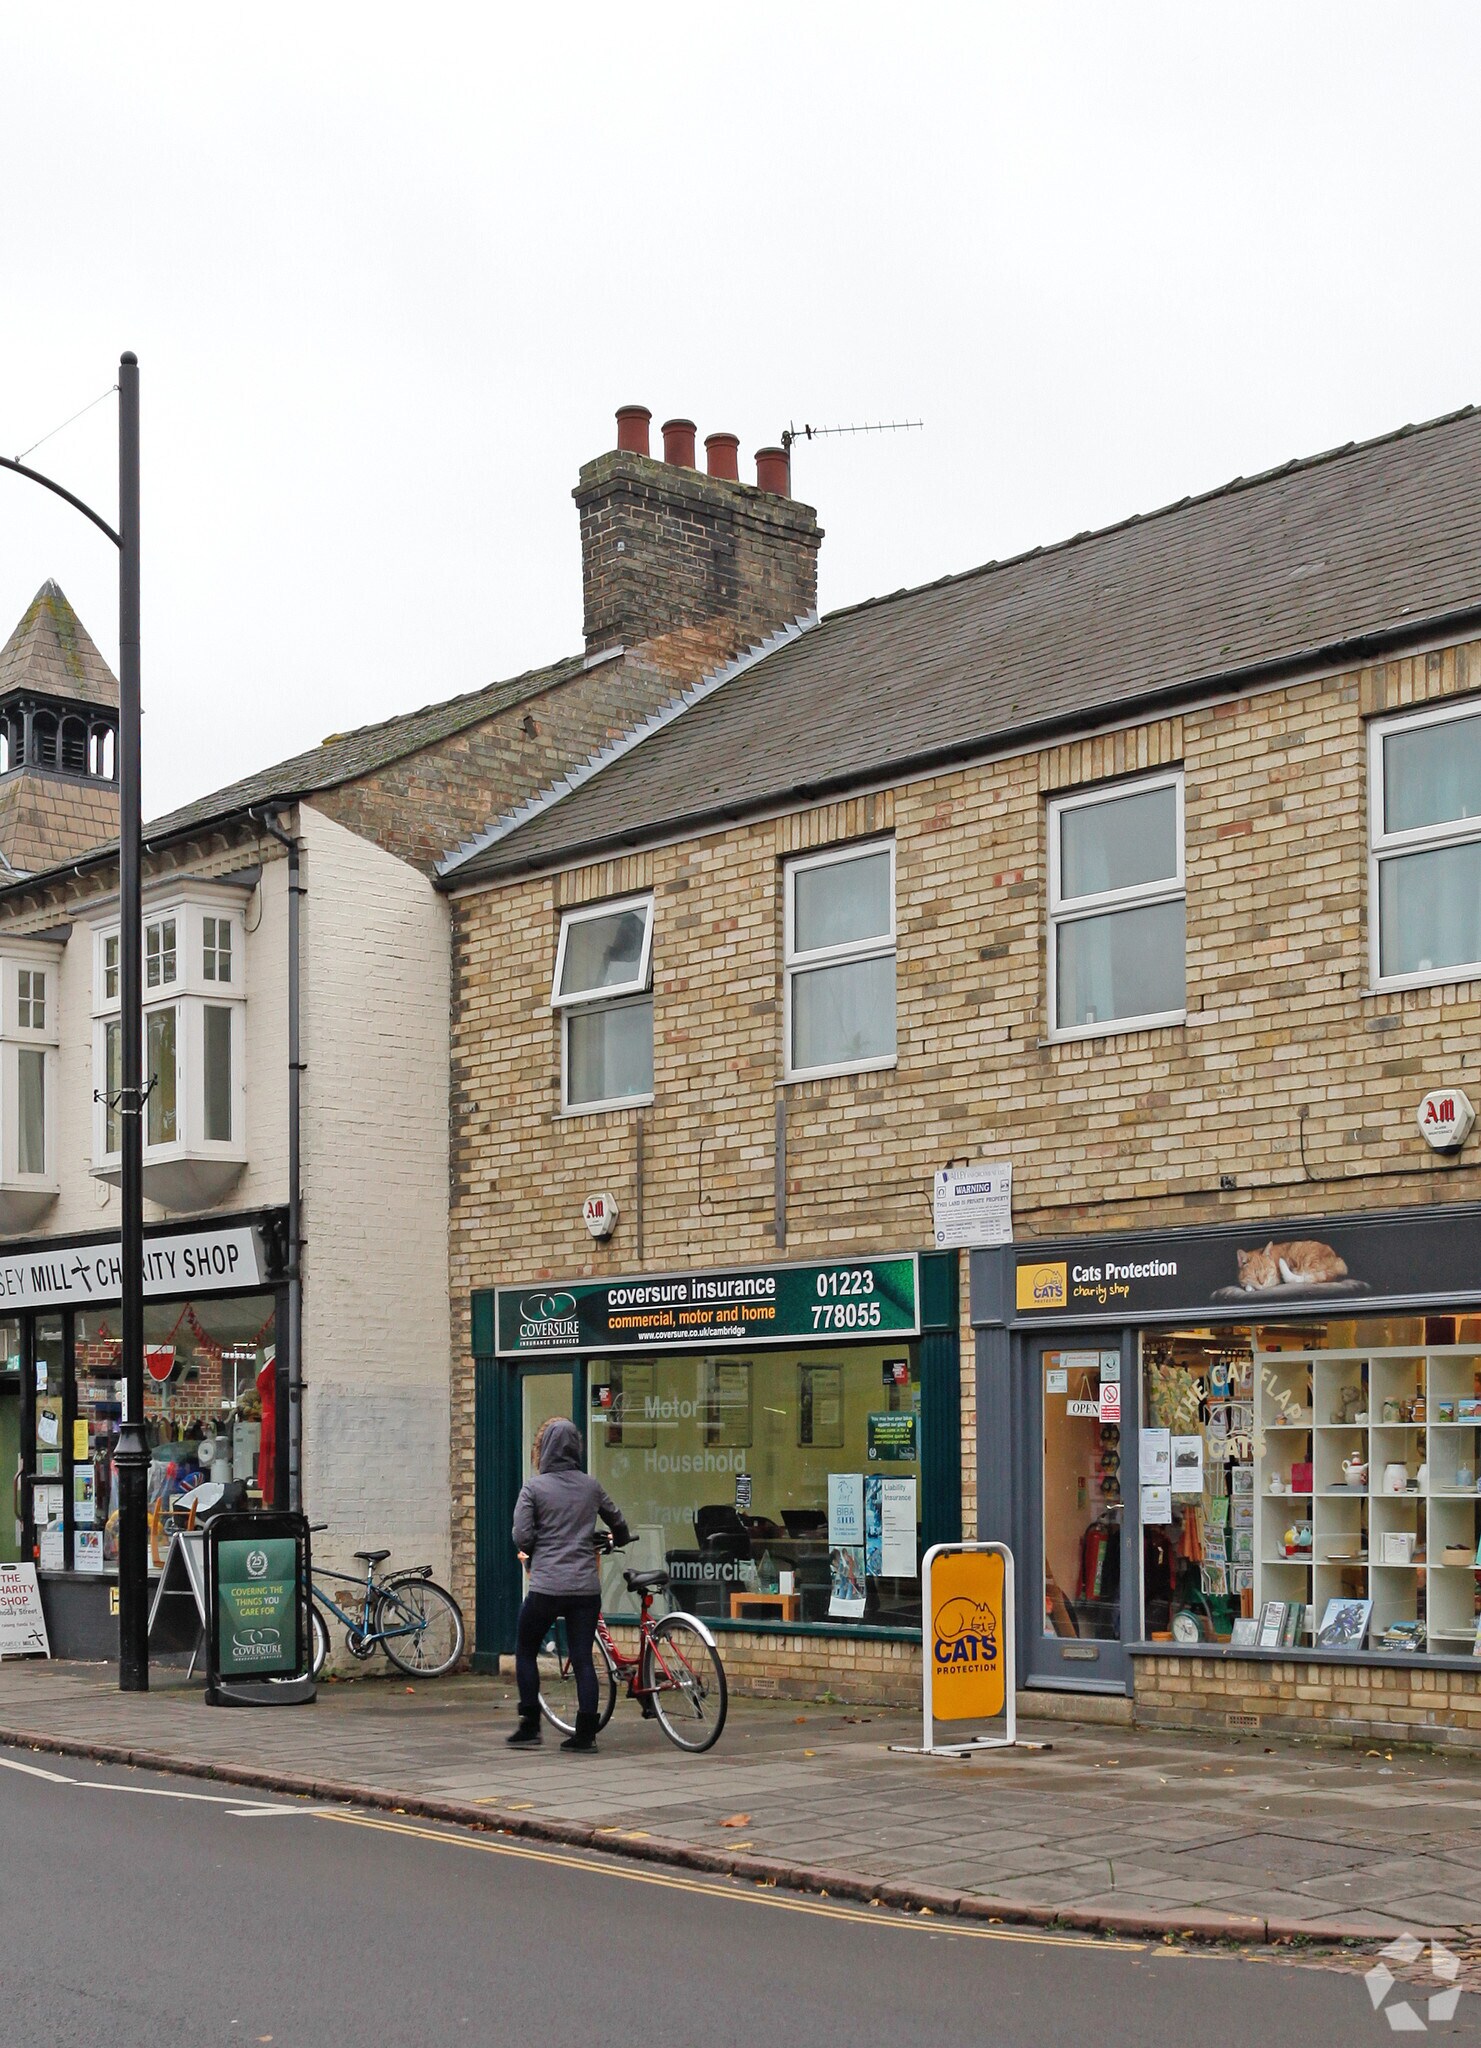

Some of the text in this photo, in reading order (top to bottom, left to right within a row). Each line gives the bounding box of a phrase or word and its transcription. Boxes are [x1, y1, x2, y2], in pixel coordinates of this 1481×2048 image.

[956, 1183, 990, 1195] WARNING
[986, 1195, 1009, 1203] PROPERTY
[31, 1263, 72, 1293] MILL
[96, 1250, 176, 1287] CHITY
[183, 1243, 239, 1278] SHOP
[1072, 1258, 1177, 1282] Cats Protection
[816, 1269, 874, 1297] 01223
[608, 1276, 776, 1306] coversure insurance
[1033, 1284, 1063, 1299] CATS
[1073, 1283, 1130, 1303] charity shop
[608, 1305, 776, 1330] commercial, motor and home
[811, 1302, 881, 1329] 778055
[520, 1320, 579, 1338] COVERSURE
[638, 1325, 746, 1341] www.coversure.co.uk/cambridge
[1174, 1361, 1303, 1423] THE CAT FLAP
[644, 1395, 699, 1419] Motor
[1072, 1402, 1099, 1414] OPEN
[1208, 1436, 1268, 1459] CATS
[644, 1449, 746, 1474] Household
[884, 1483, 906, 1492] Liability
[884, 1494, 911, 1502] Insurance
[646, 1501, 699, 1524] Travel
[836, 1507, 854, 1516] BIBA
[1, 1574, 21, 1583] THE
[231, 1585, 283, 1597] COVERING THE
[1, 1597, 29, 1606] SHOP
[236, 1596, 280, 1607] THINGS YOU
[19, 1607, 38, 1615] Street
[240, 1606, 275, 1616] CARE FOR
[232, 1643, 282, 1656] COVERSURE
[934, 1634, 998, 1664] CATS
[936, 1663, 997, 1675] PROTECTION
